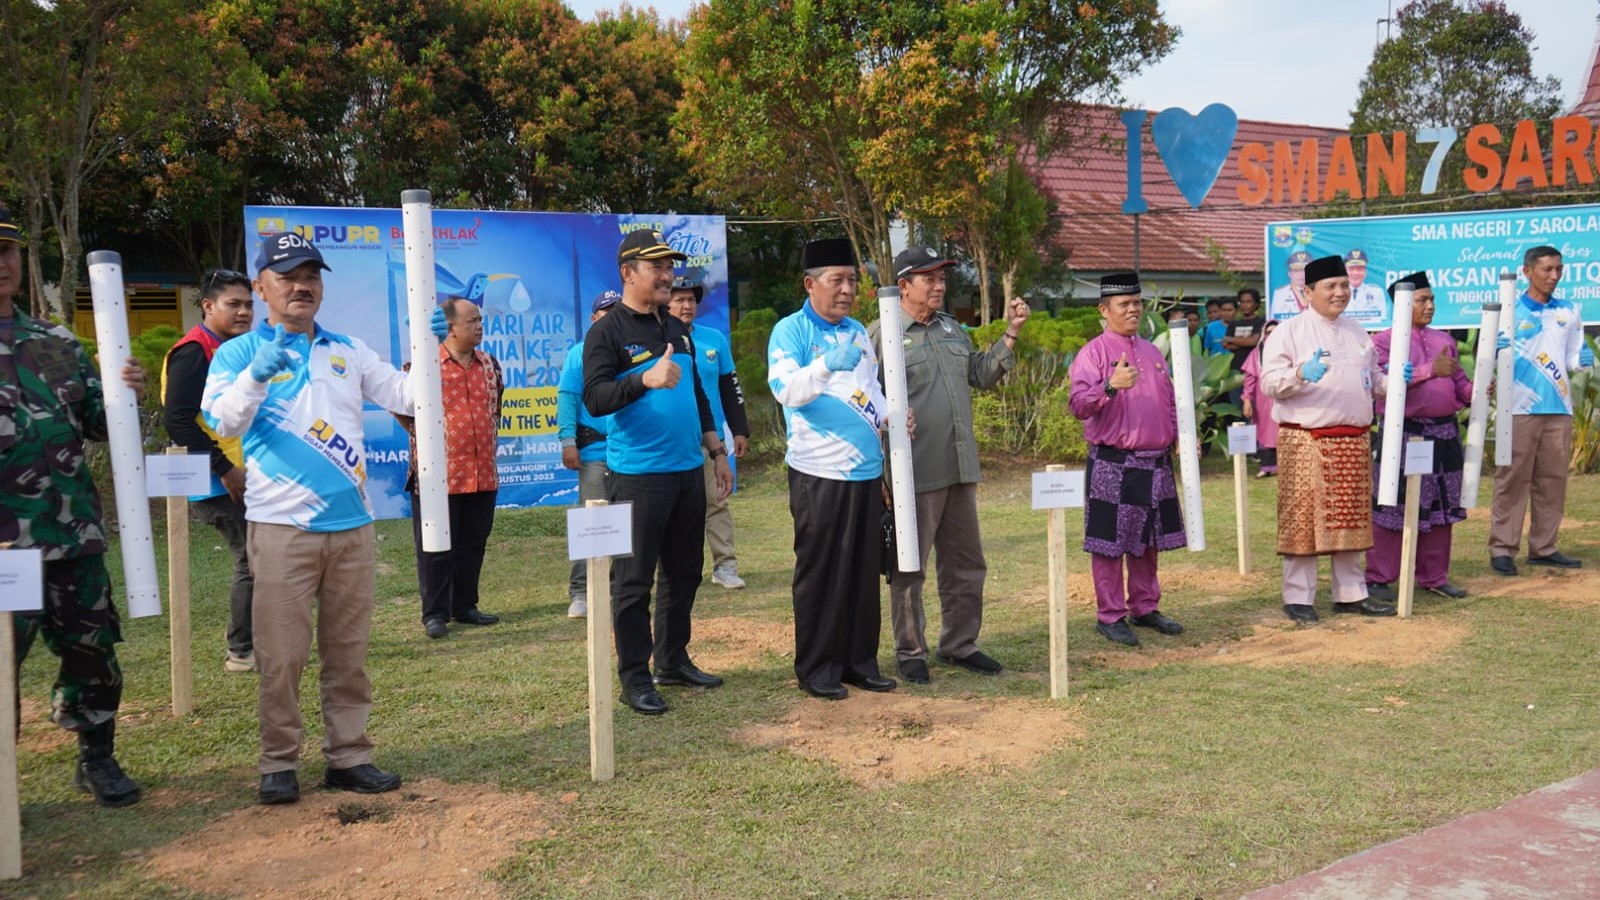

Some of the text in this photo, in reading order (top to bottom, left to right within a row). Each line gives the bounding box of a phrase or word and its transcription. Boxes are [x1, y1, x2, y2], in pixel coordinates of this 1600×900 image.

[1121, 109, 1600, 213] I SMAN 7 SAR
[314, 225, 381, 244] PUPR
[1411, 223, 1448, 241] SMA
[1451, 219, 1511, 239] NEGERI
[1515, 219, 1526, 236] 7
[278, 234, 312, 250] SDA
[686, 254, 714, 268] 2023
[1448, 288, 1501, 304] TINGKAT
[531, 311, 565, 336] AIR
[502, 398, 531, 409] ANGE
[516, 414, 541, 430] THE
[303, 434, 323, 452] SIGAP
[533, 472, 555, 481] 2023
